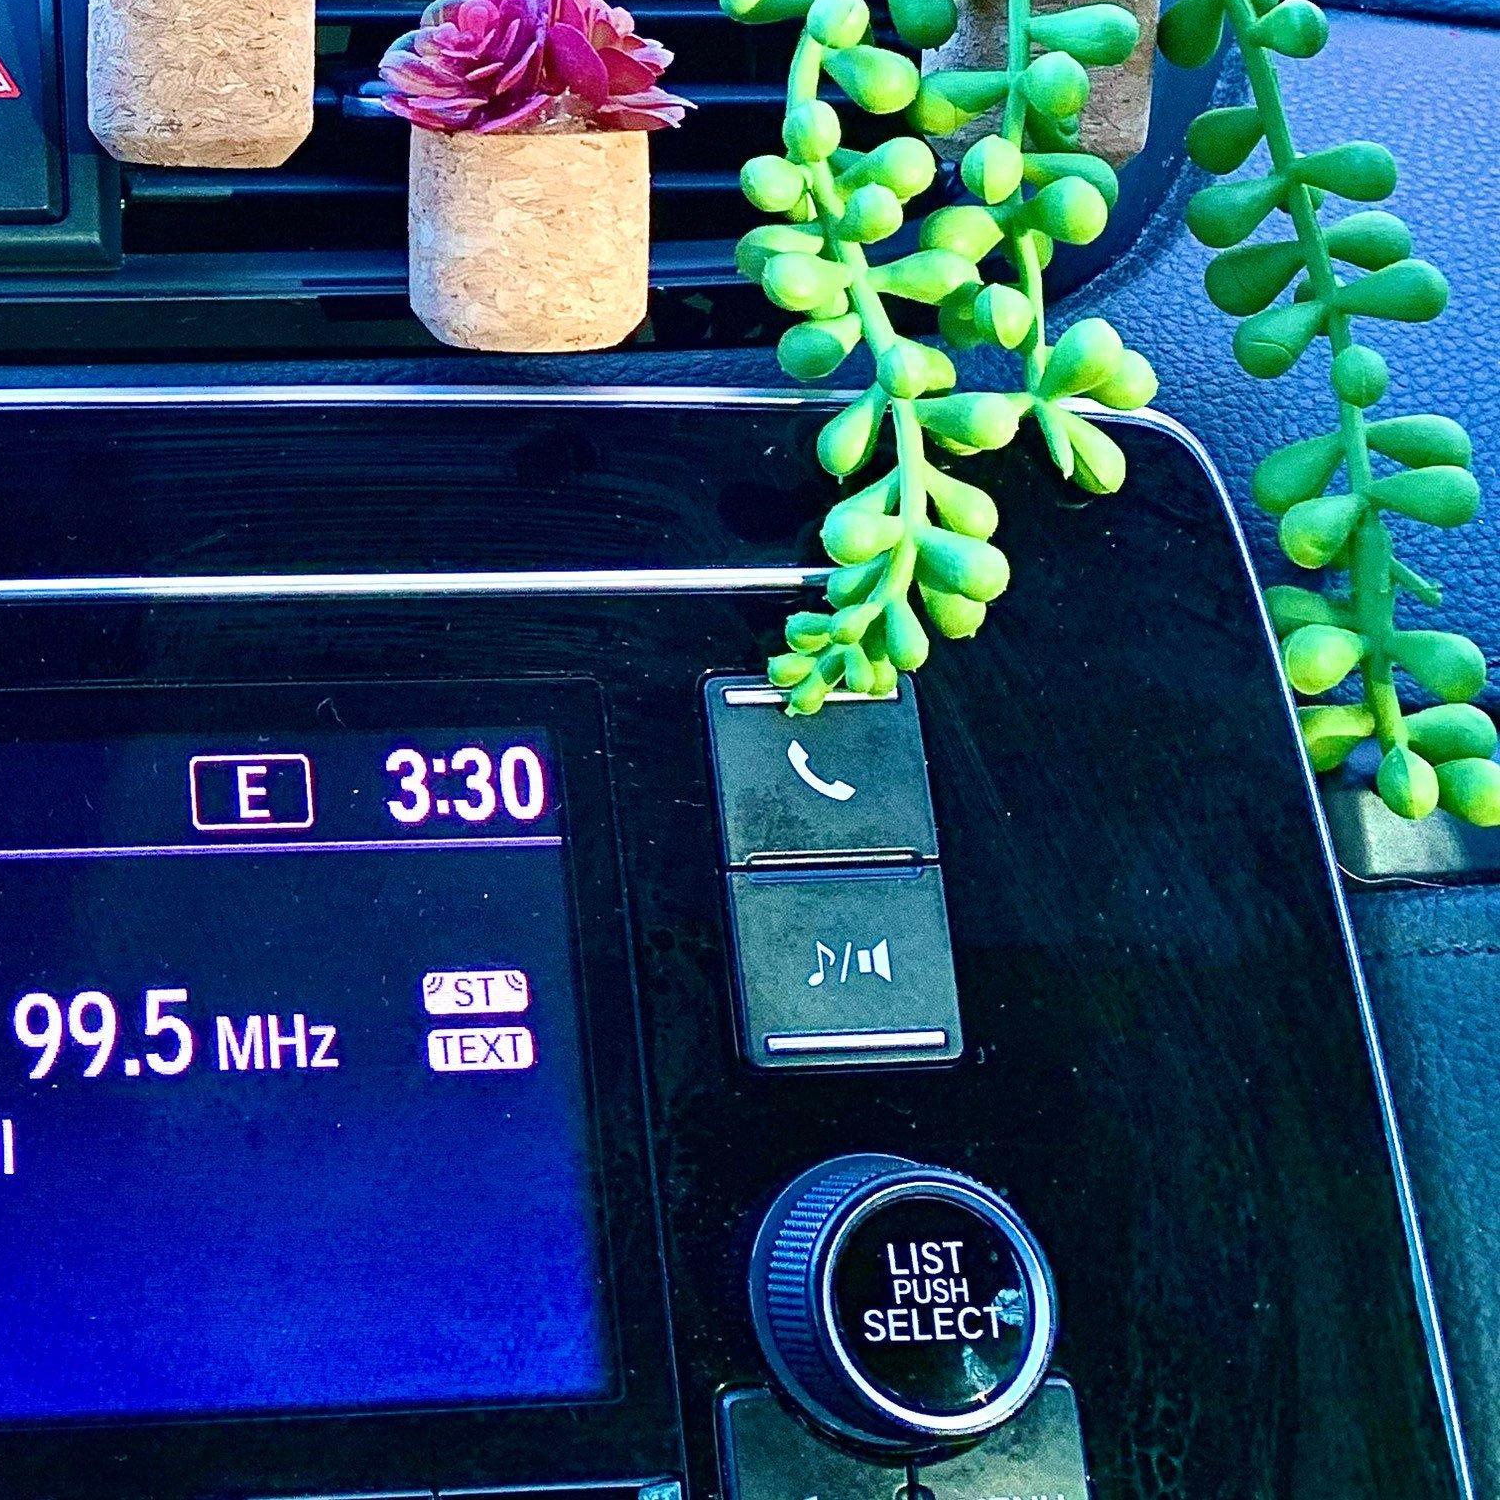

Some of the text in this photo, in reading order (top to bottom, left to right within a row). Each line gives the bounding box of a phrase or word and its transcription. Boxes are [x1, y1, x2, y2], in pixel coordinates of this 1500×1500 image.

[237, 765, 271, 819] E
[384, 745, 546, 823] 3:30
[454, 977, 495, 1007] ST
[12, 988, 340, 1080] 99.5 MHz
[434, 1033, 523, 1065] TEXT
[886, 1240, 964, 1276] LIST
[893, 1277, 970, 1305] PUSH
[863, 1305, 1003, 1342] SELECT
